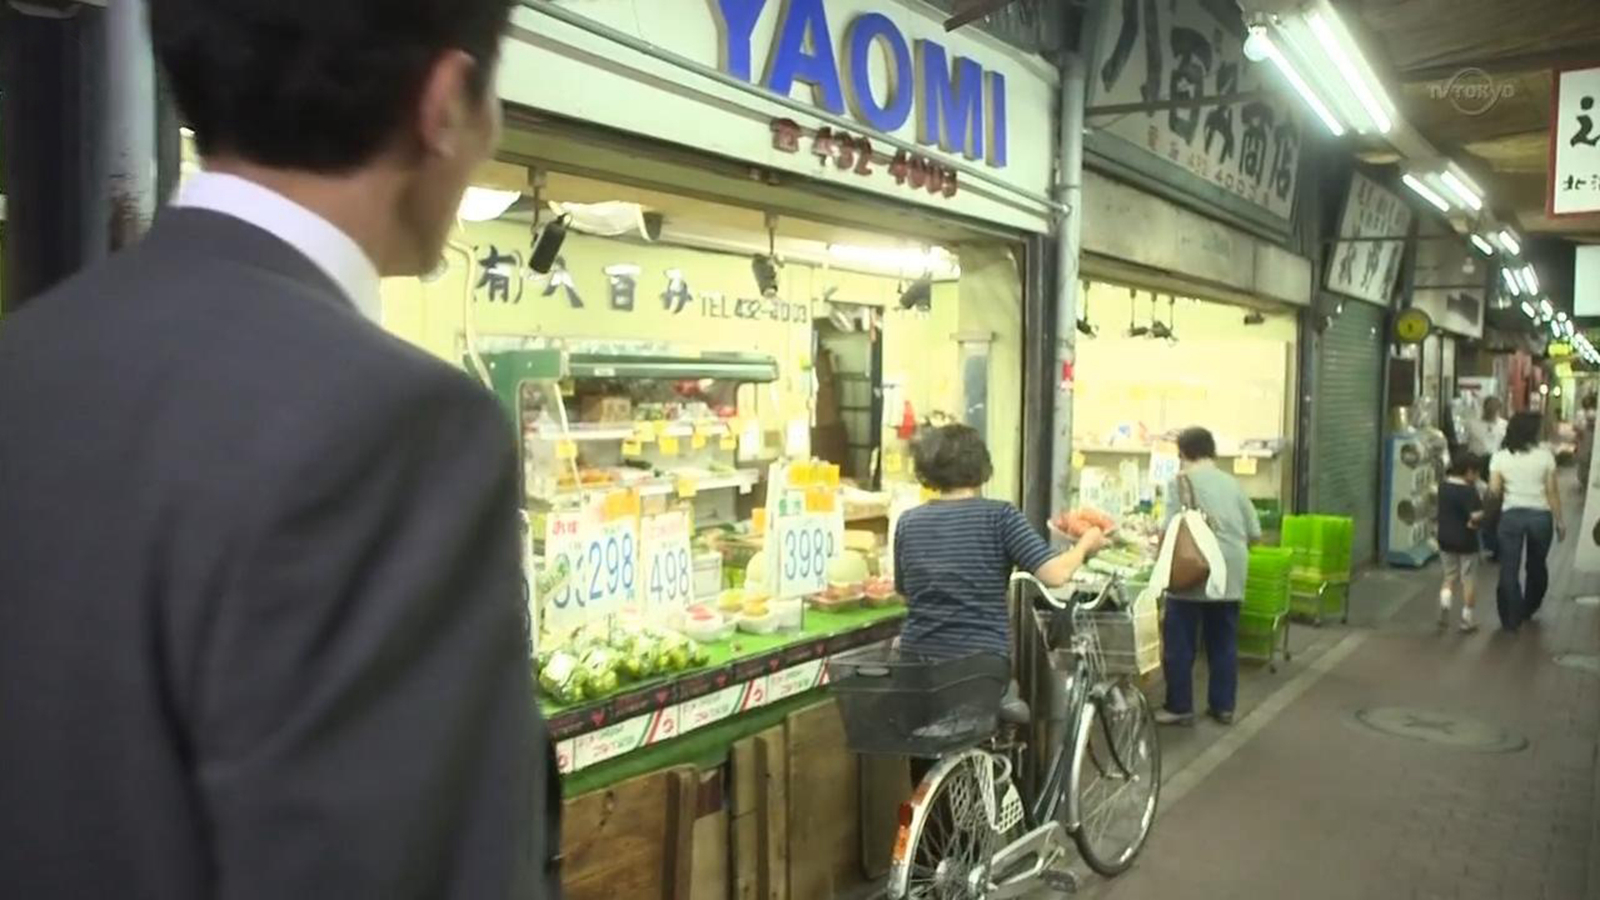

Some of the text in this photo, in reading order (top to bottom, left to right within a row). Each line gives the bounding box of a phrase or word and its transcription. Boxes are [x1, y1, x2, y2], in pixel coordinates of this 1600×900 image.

[709, 0, 1007, 168] YAOMI
[701, 295, 731, 318] TEL
[589, 532, 634, 600] 298
[650, 547, 690, 603] 498
[783, 528, 825, 581] 398
